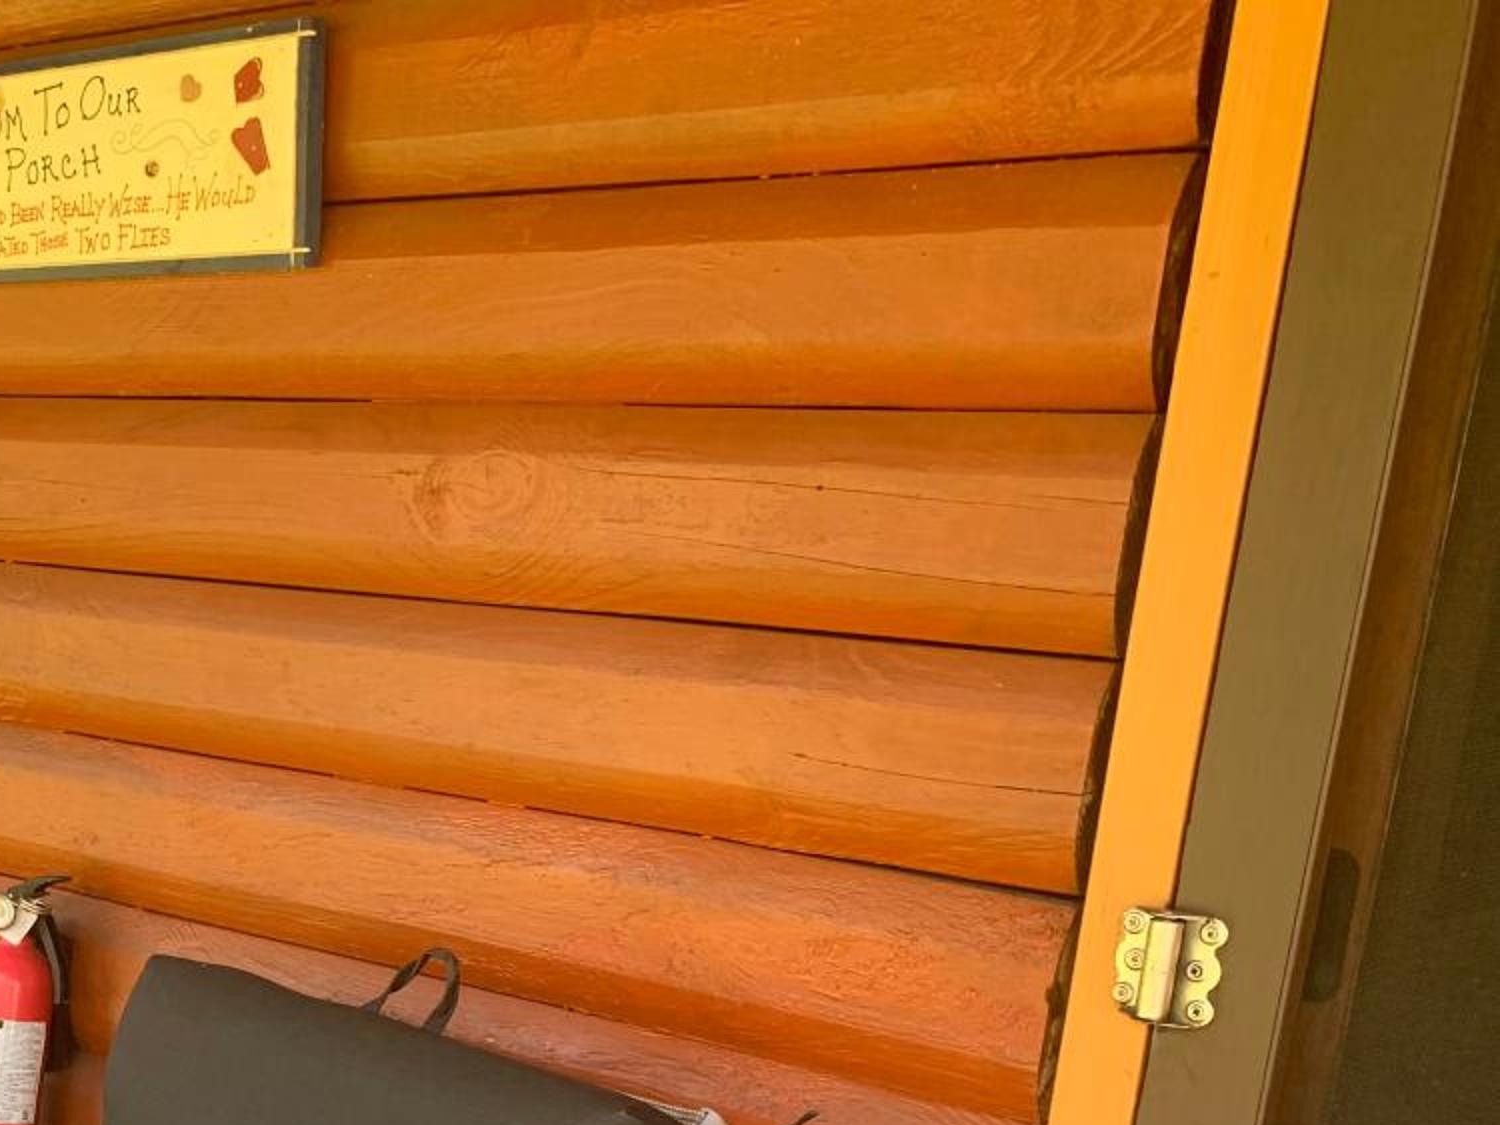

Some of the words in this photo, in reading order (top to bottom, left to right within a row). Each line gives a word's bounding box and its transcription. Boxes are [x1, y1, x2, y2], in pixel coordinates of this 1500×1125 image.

[34, 82, 70, 136] TO
[80, 76, 140, 120] OUR
[5, 143, 101, 193] PORCH
[9, 201, 45, 228] BEEN
[51, 192, 105, 224] REALLY
[165, 173, 191, 221] HE
[193, 171, 256, 212] WOULD
[74, 226, 111, 255] TWO
[117, 223, 171, 250] FLIES
